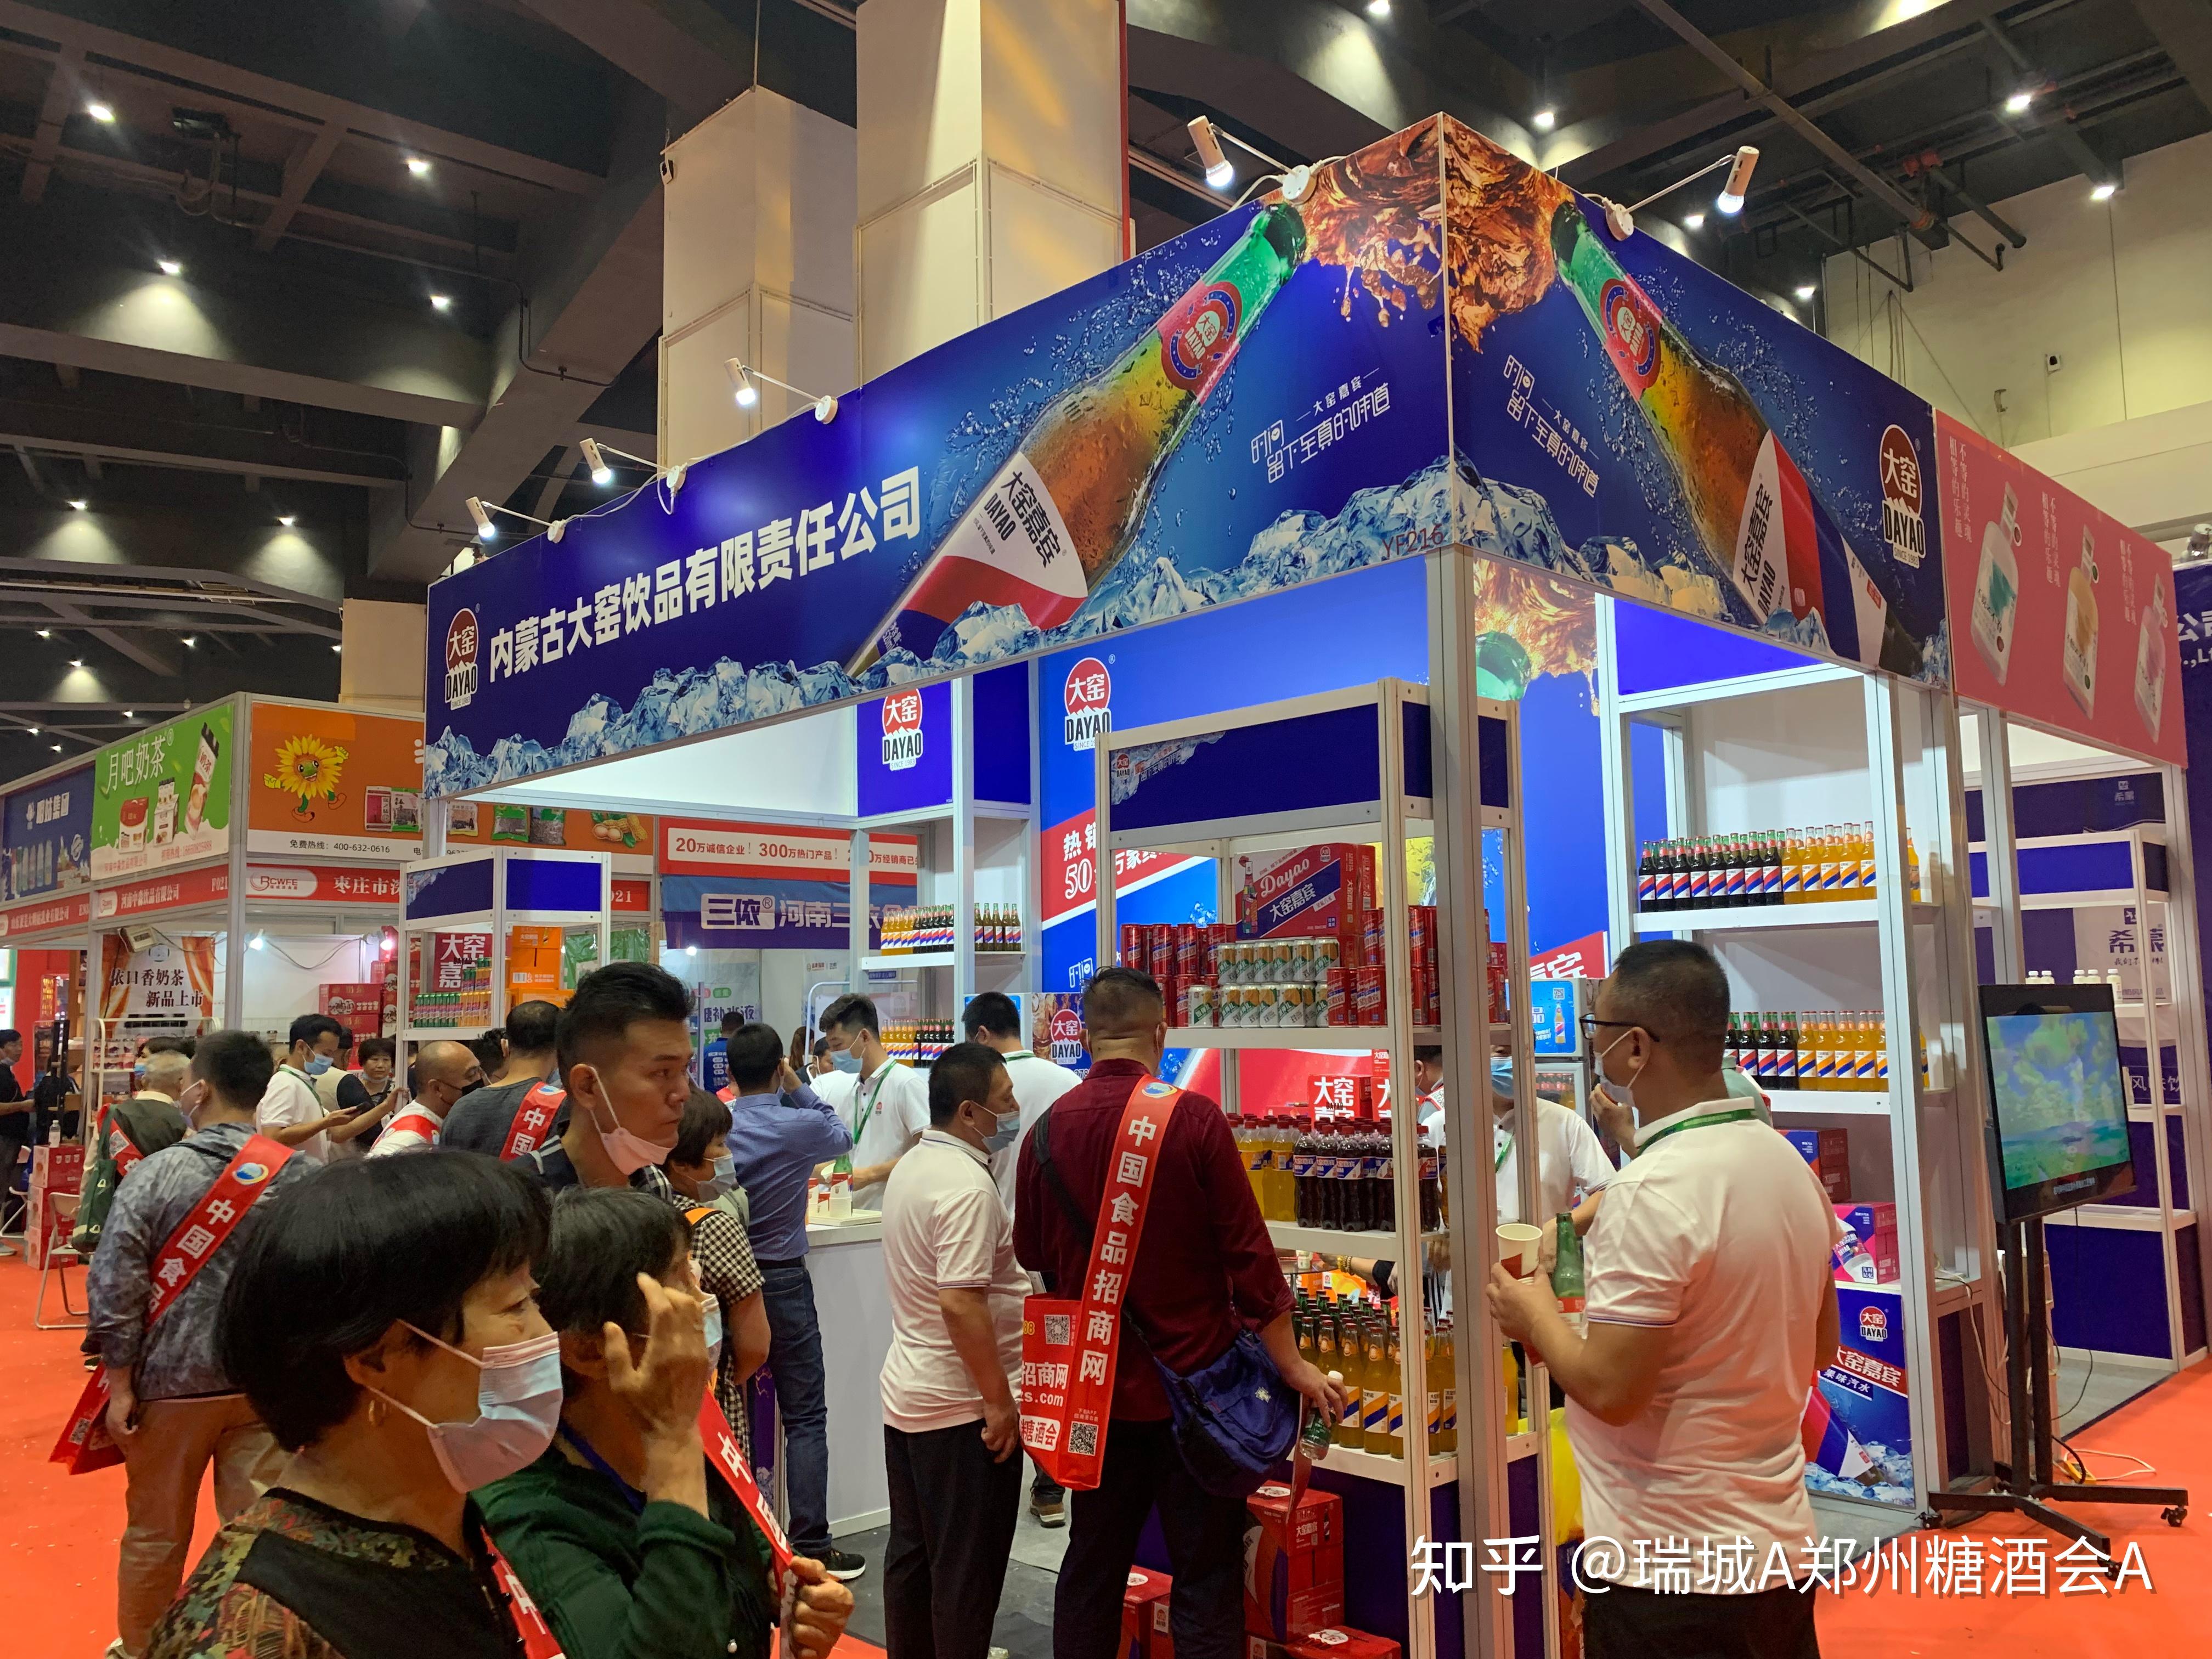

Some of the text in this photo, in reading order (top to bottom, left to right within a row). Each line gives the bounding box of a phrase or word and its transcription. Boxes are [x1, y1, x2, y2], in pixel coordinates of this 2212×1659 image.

[1313, 375, 1362, 417] 大窑嘉宾
[1883, 448, 1917, 498] 大窑
[984, 493, 1017, 541] DAYAO
[1001, 471, 1061, 568] 大窑嘉宾
[1884, 504, 1925, 556] DAYAO
[1382, 523, 1445, 558] YF216
[1741, 483, 1773, 597] 大窑嘉宾
[490, 466, 921, 683] 内蒙古大窑饮品有限责任公司
[1758, 560, 1776, 617] DAYAO
[449, 625, 475, 661] 大窑
[446, 665, 476, 701] DAYAO
[1068, 673, 1105, 706] 大窑
[886, 695, 917, 726] 大窑
[1066, 711, 1110, 744] DAYAO
[884, 732, 922, 762] DAYAO
[1075, 741, 1089, 749] SINCE
[106, 735, 166, 794] 月吧奶茶
[891, 758, 915, 769] SINCE 1983
[1117, 769, 1130, 777] DAYAO
[334, 843, 390, 853] 400-632-0616
[413, 847, 423, 856] 电
[1260, 859, 1310, 898] Dayao
[707, 898, 760, 926] 三依
[1269, 883, 1316, 923] 大窑嘉宾
[440, 934, 486, 961] 大窑
[145, 990, 204, 1008] 新品上市
[1054, 1020, 1078, 1036] 大窑
[1052, 1043, 1081, 1058] DAYAO
[1313, 1076, 1355, 1106] 大窑
[1079, 1115, 1157, 1386] 中国食品招商网
[1861, 1327, 1887, 1338] DAYAO
[1863, 1313, 1883, 1324] 大窑
[1824, 1368, 1870, 1392] 果味汽水
[1021, 1418, 1057, 1447] 糖酒会
